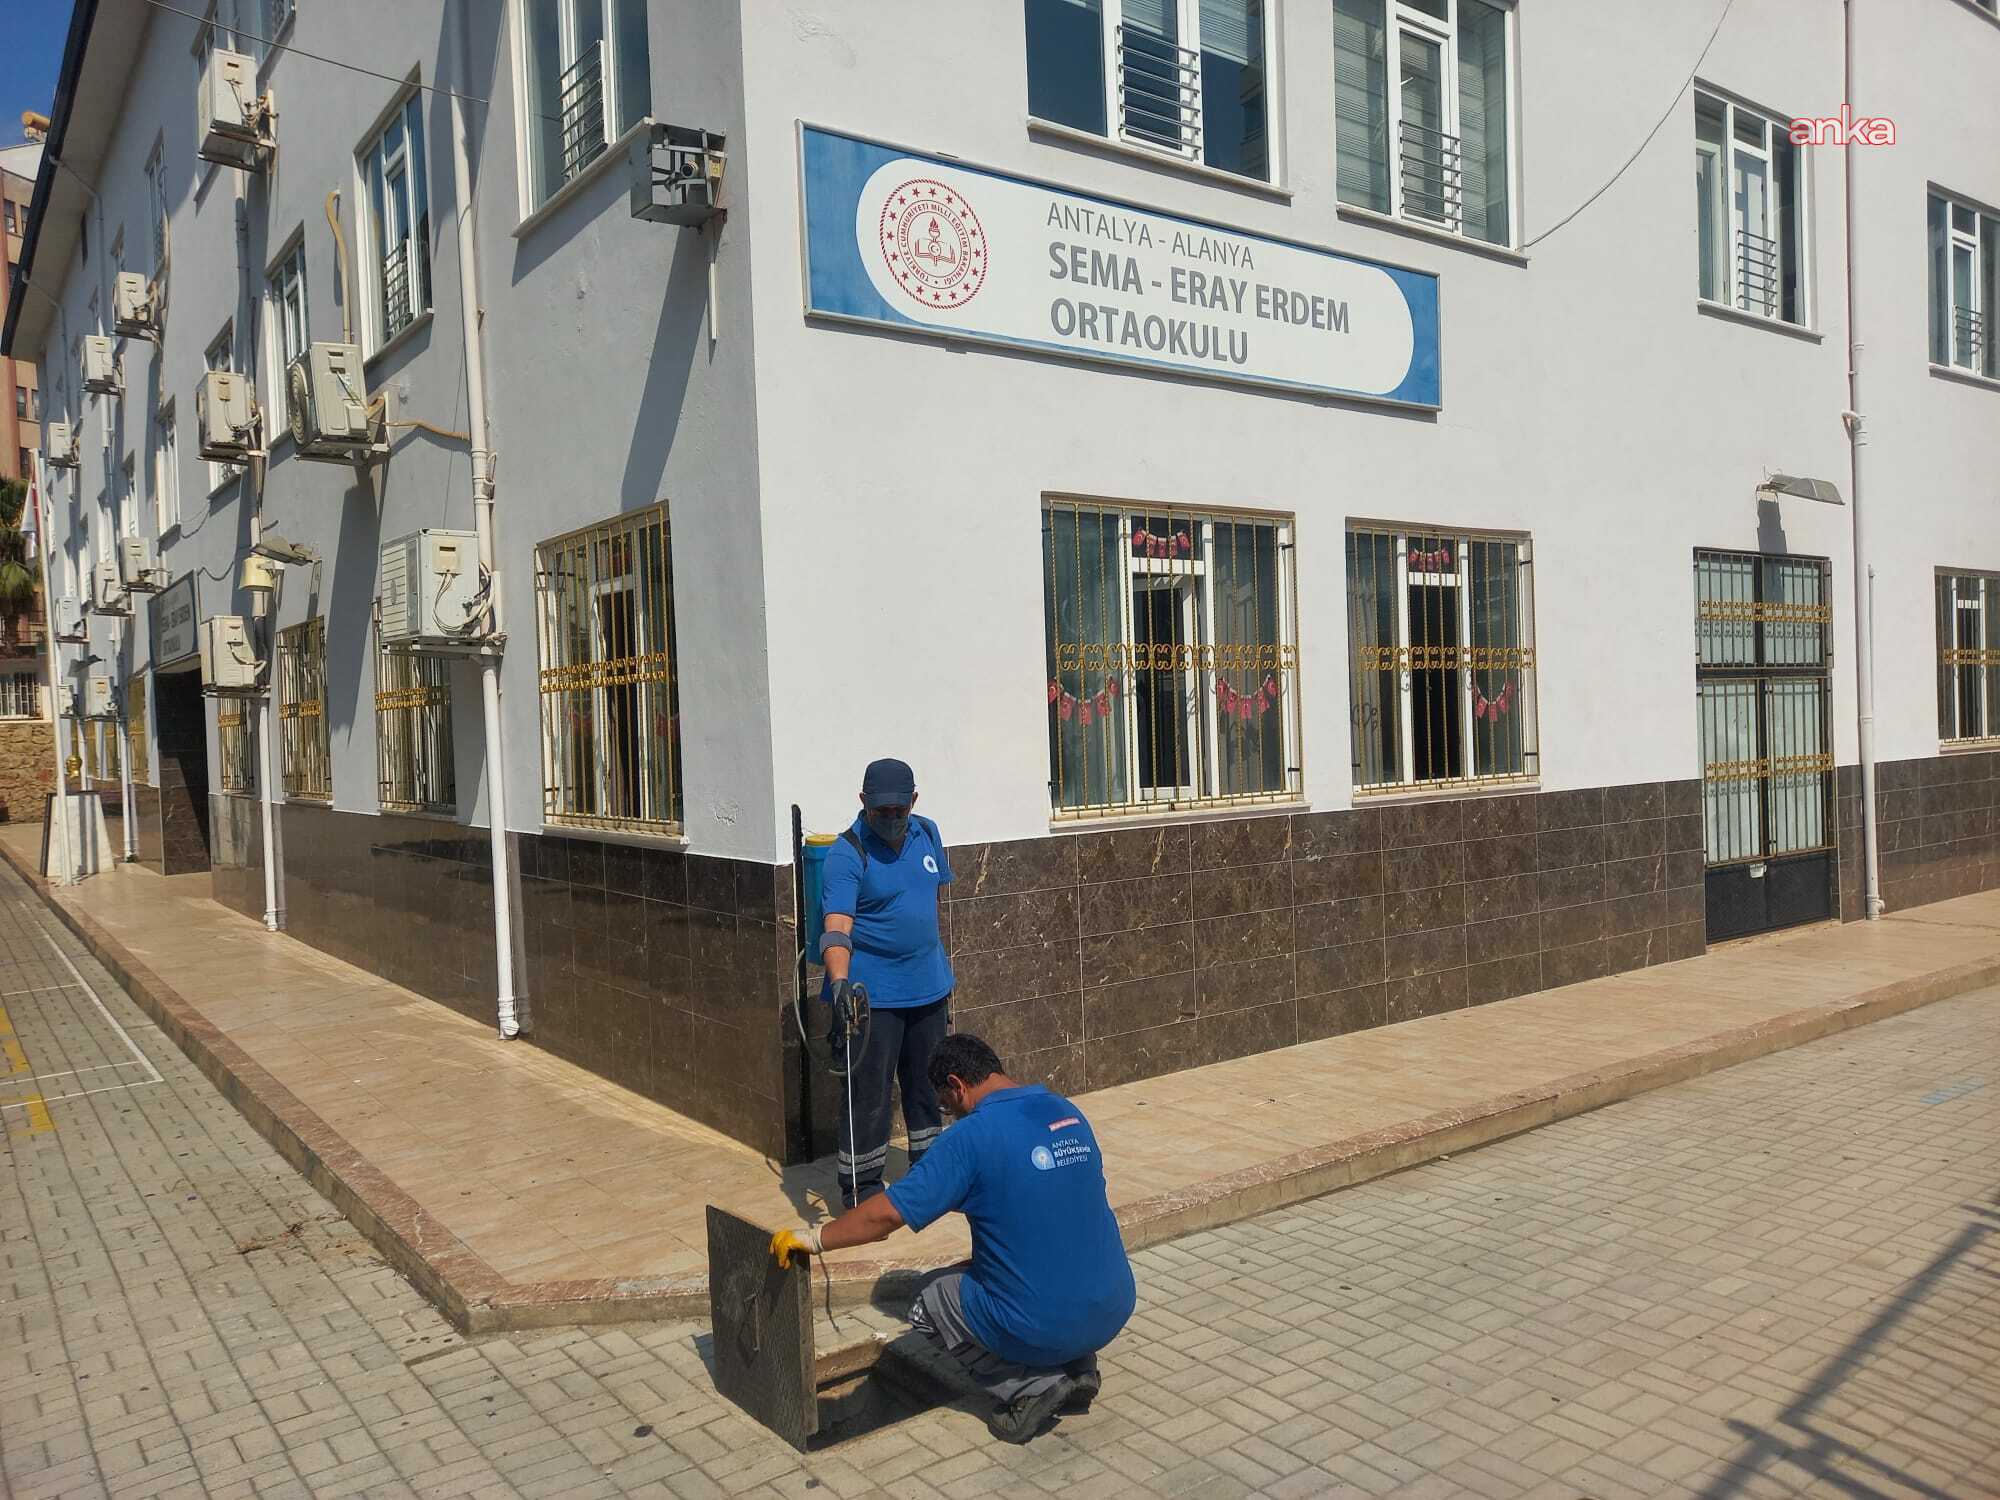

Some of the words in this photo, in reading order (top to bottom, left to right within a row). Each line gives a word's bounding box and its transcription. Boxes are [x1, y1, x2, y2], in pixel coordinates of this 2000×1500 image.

[1047, 202, 1152, 249] ANTALYA
[1172, 231, 1254, 271] ALANYA
[1049, 241, 1144, 296] SEMA
[1171, 266, 1248, 314] ERAY
[1255, 284, 1350, 334] ERDEM
[1050, 297, 1248, 365] ORTAOKULU
[1052, 1138, 1079, 1149] ANTALYA
[1056, 1155, 1088, 1167] BELEDİYESİ
